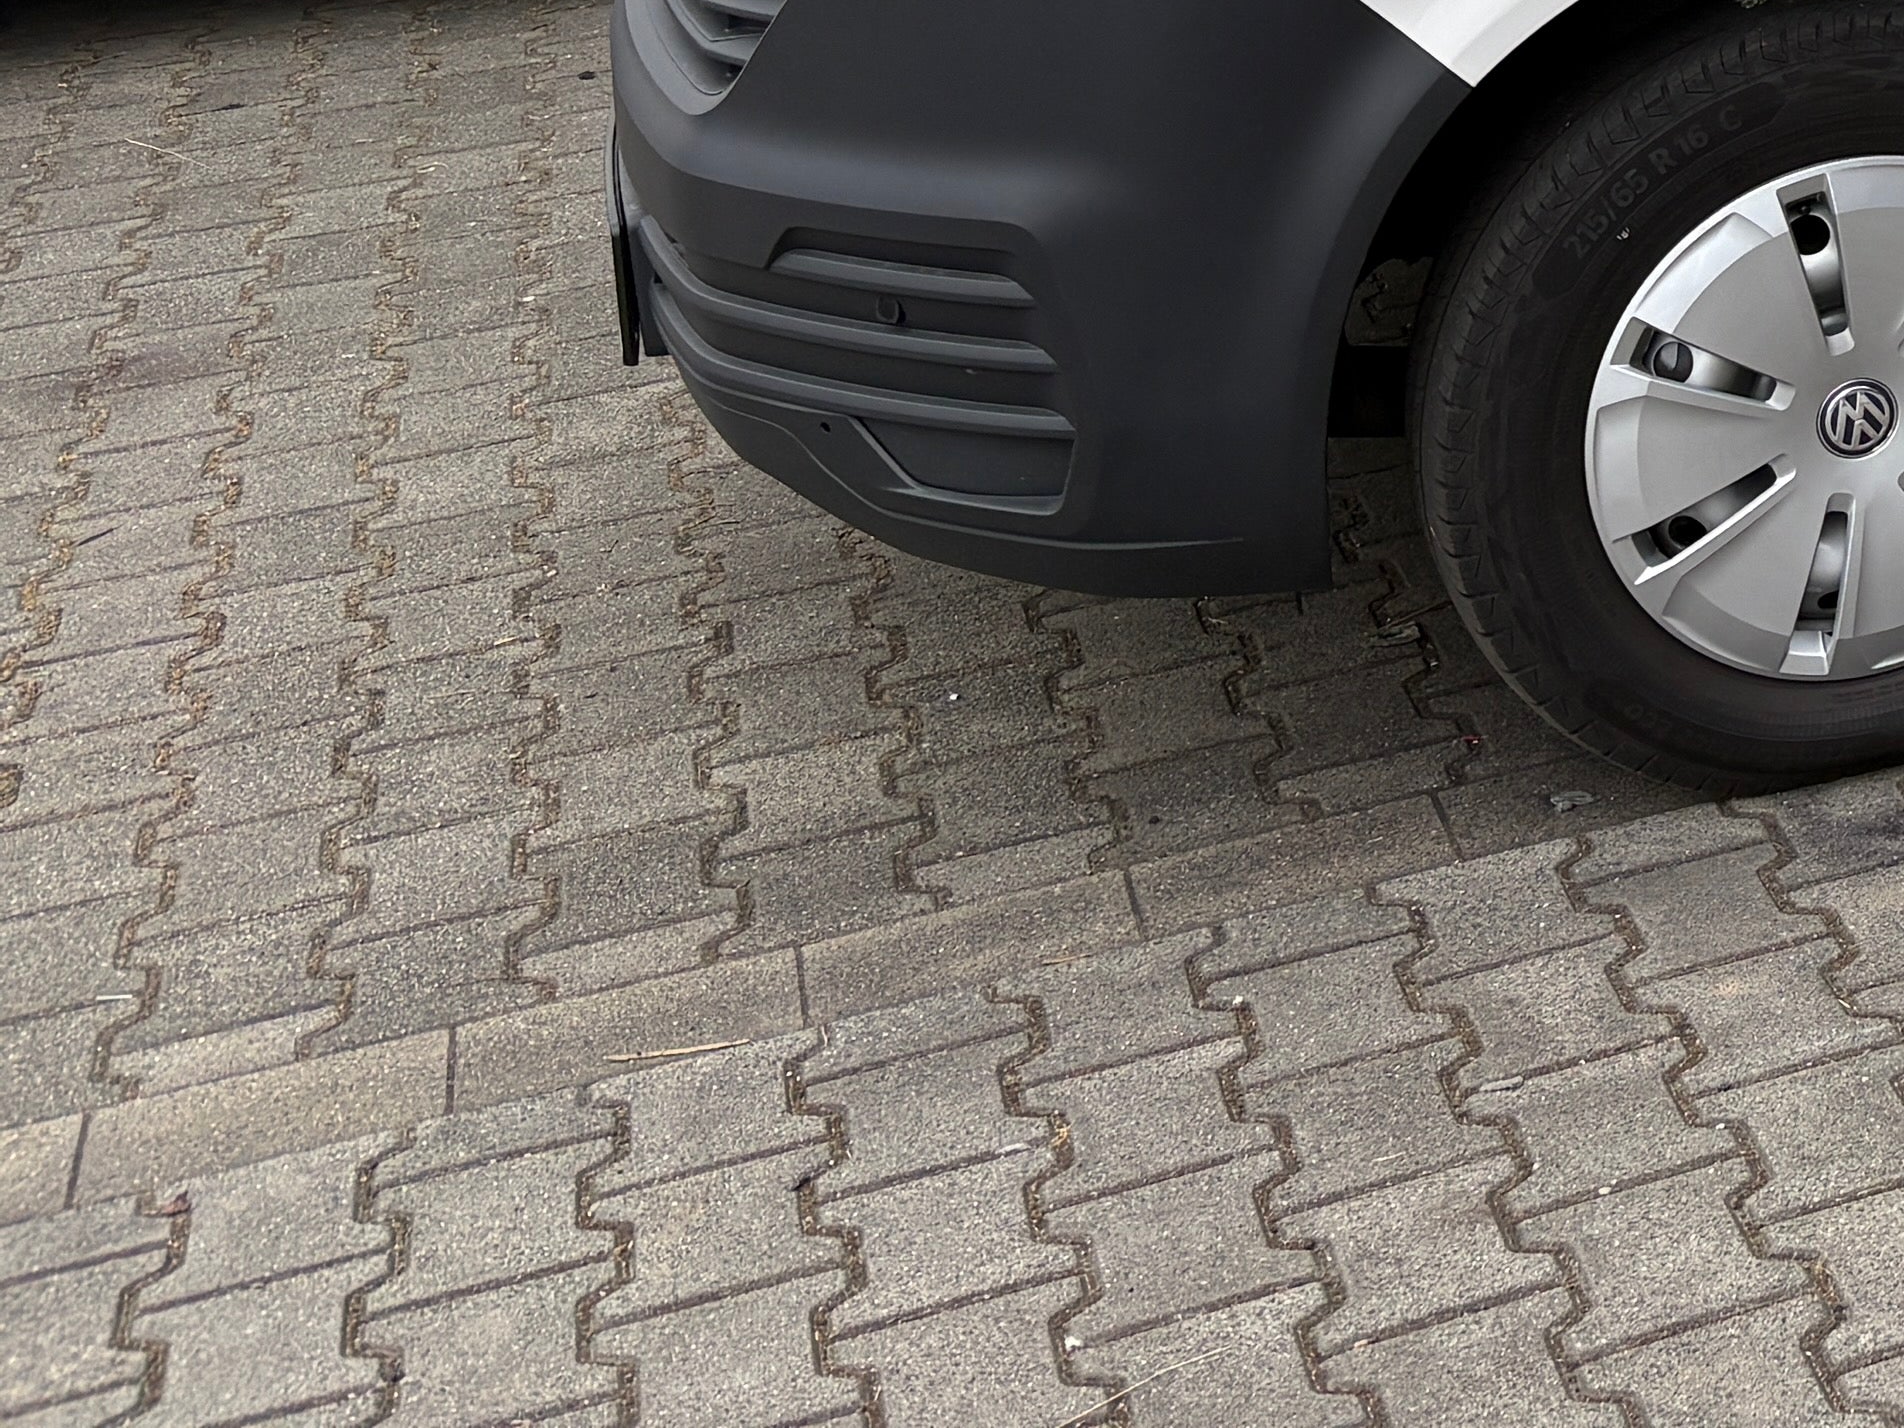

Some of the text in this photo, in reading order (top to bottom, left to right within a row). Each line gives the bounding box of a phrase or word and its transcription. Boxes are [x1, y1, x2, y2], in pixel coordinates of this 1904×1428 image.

[1563, 103, 1743, 259] 215/65 R 16 C
